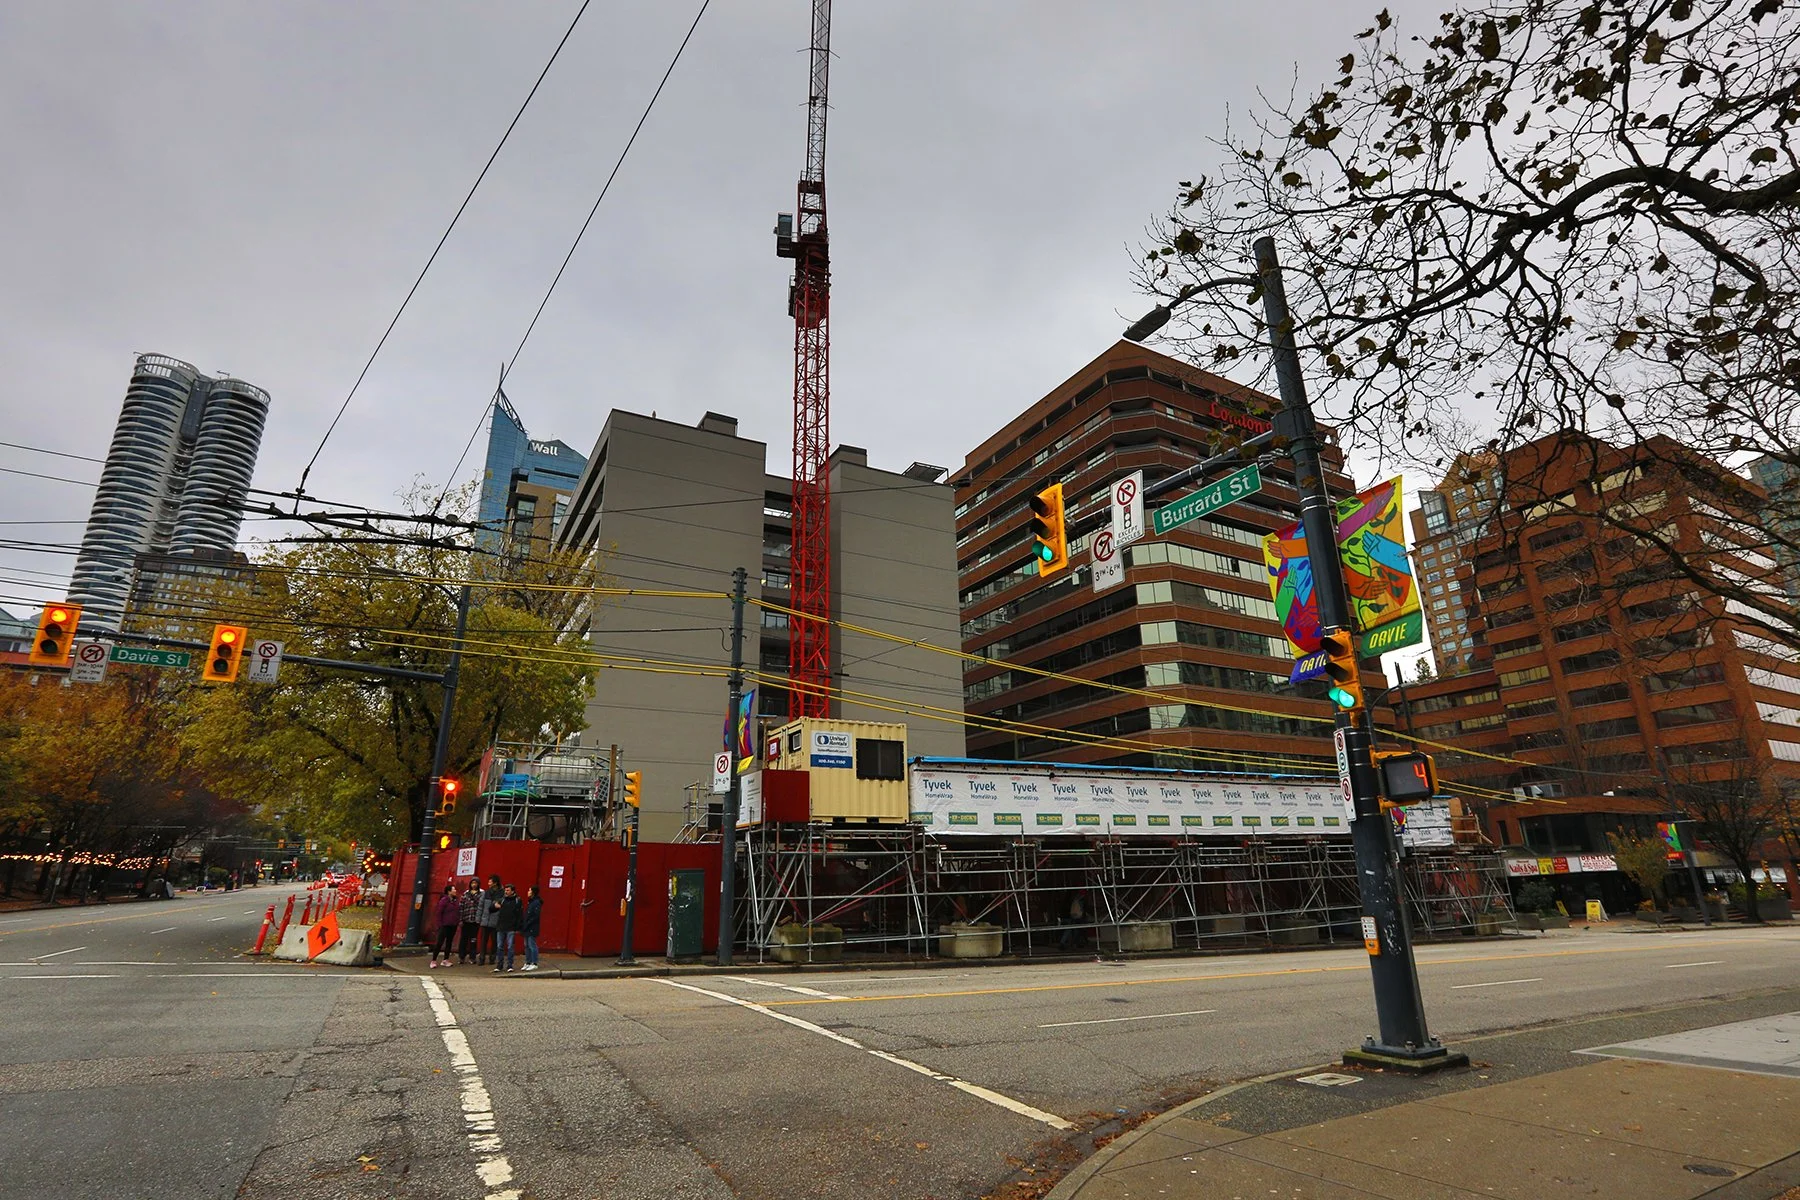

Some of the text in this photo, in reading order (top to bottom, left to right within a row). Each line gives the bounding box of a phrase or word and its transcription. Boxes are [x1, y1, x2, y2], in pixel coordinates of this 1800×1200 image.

[531, 442, 558, 456] Wall
[1161, 476, 1251, 528] Burrard St
[1116, 530, 1141, 545] BICYCLES
[1118, 525, 1138, 539] EXCEPT
[1369, 623, 1408, 649] DAVIE
[117, 649, 182, 665] Davie St
[1414, 763, 1428, 788] 4
[923, 779, 952, 791] Tyvek
[968, 780, 996, 793] Tyvek
[1011, 782, 1038, 794] Tyvek
[1052, 783, 1077, 795] Tyvek
[1090, 785, 1113, 796] Tyvek
[1126, 786, 1148, 797] Tyvek
[1160, 787, 1181, 798] Tyvek
[1192, 788, 1212, 799] Tyvek
[1222, 790, 1242, 800] Tyvek
[1251, 791, 1270, 801] Tyvek
[1279, 791, 1296, 801] Tyvek
[1305, 792, 1322, 801] Tyvek
[1330, 793, 1343, 802] Tyve
[461, 850, 473, 862] 981
